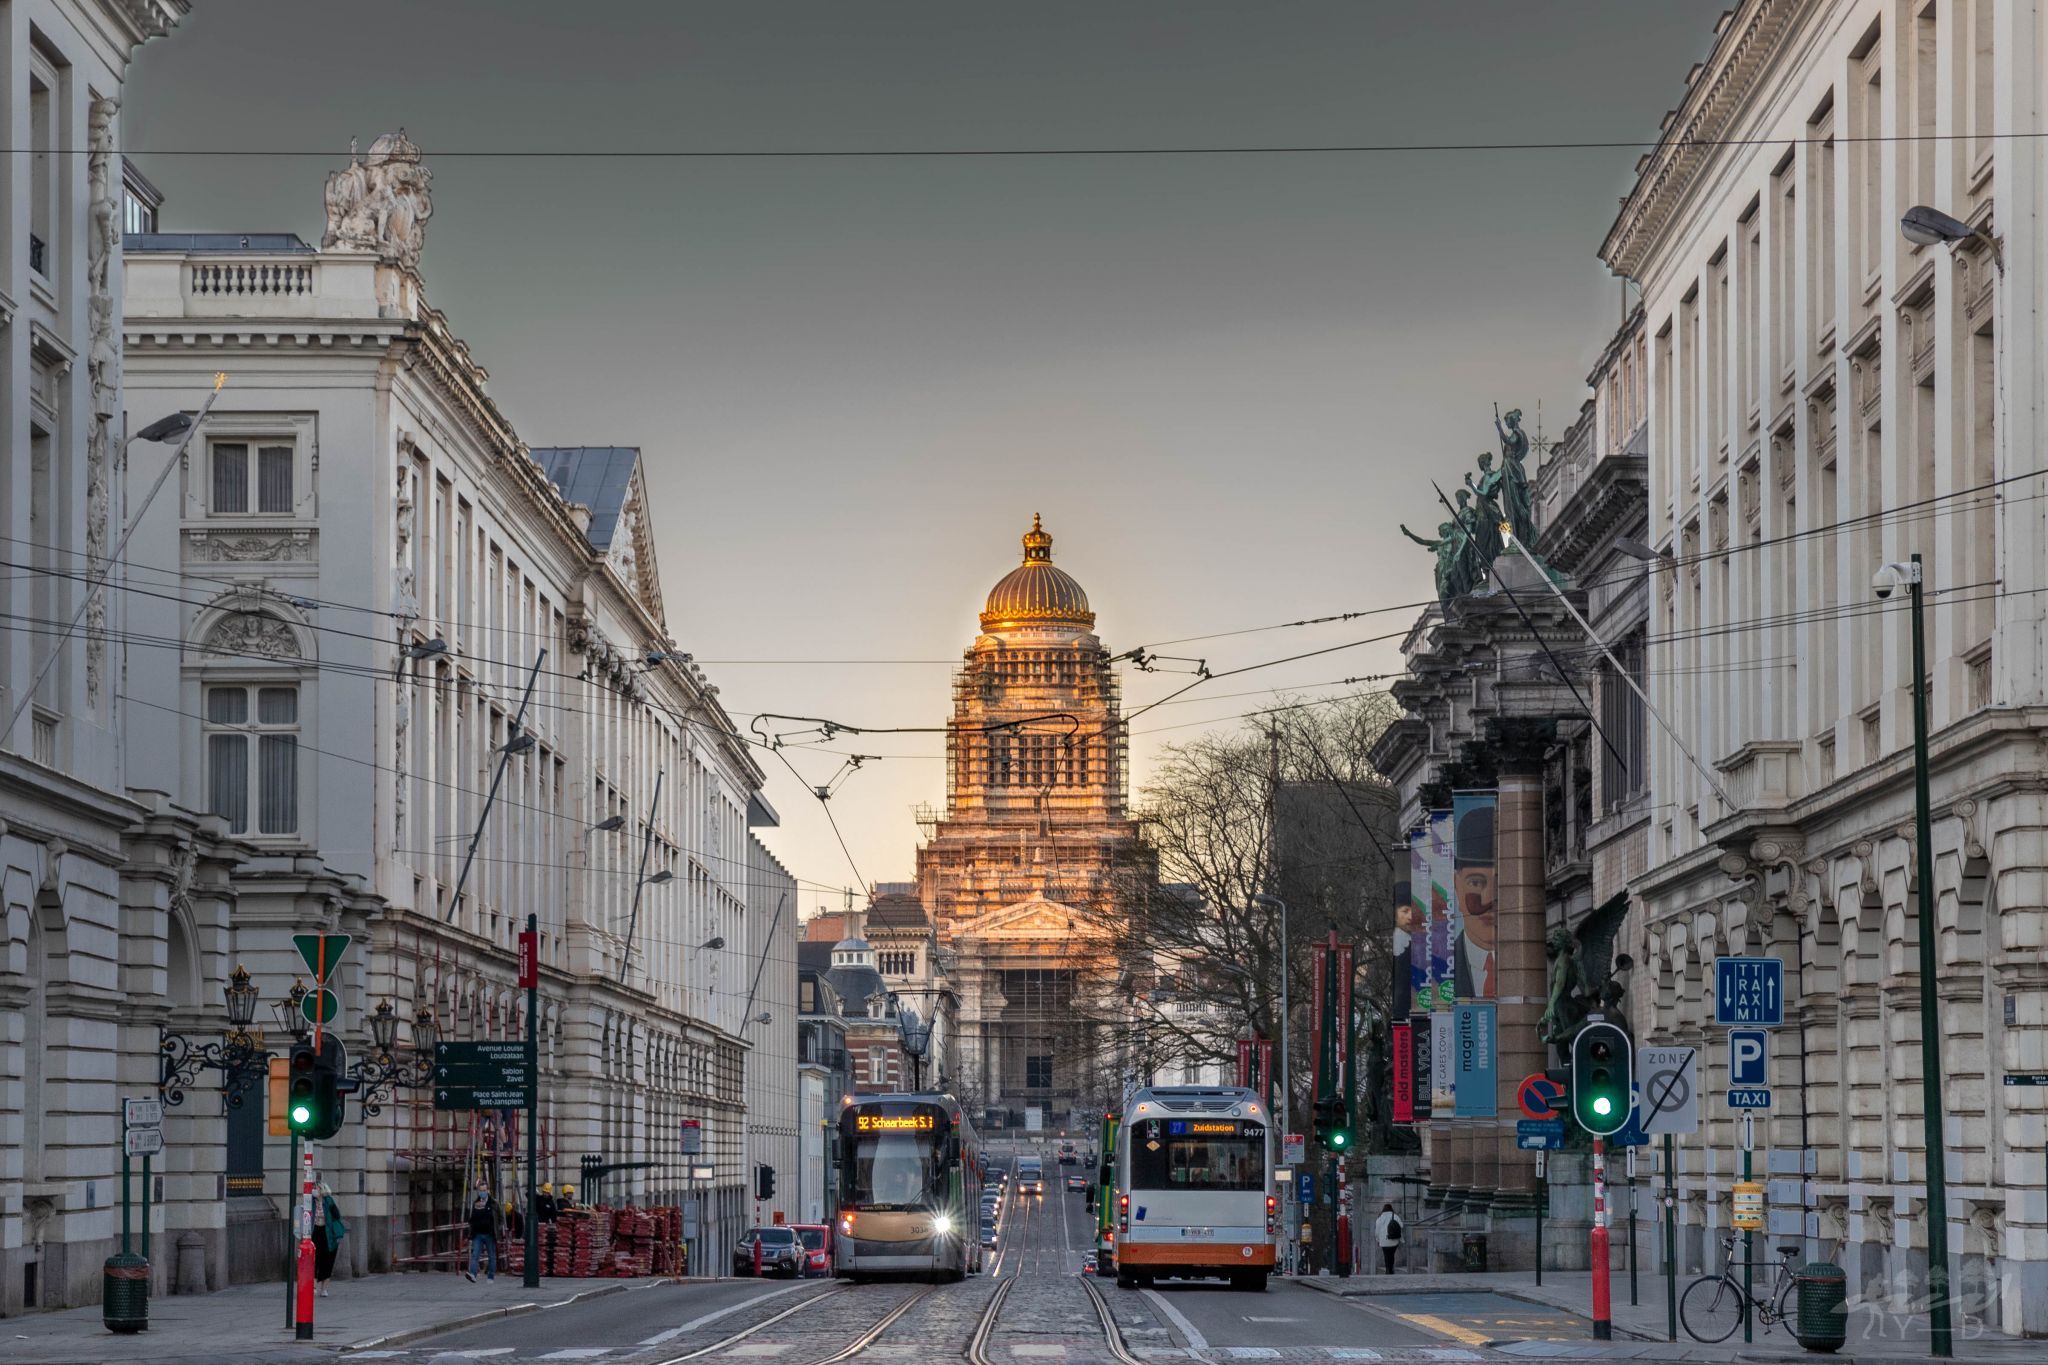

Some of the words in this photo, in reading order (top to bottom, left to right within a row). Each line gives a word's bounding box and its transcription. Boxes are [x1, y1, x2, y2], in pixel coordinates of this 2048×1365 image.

[1737, 964, 1749, 1021] TRAM
[1751, 964, 1761, 1021] TAXI
[1417, 1030, 1430, 1072] VIOLA
[1459, 1011, 1474, 1072] magritte
[1478, 1011, 1488, 1069] museum
[1400, 1031, 1409, 1080] masters
[1648, 1053, 1686, 1064] ZONE
[1733, 1039, 1762, 1078] P
[1399, 1082, 1409, 1102] old
[1418, 1074, 1430, 1101] BILL
[1733, 1092, 1766, 1105] TAXI
[858, 1116, 869, 1130] 92
[872, 1116, 918, 1129] Schaarbeek
[919, 1116, 927, 1128] S.
[1193, 1124, 1235, 1133] Zuidstation
[1243, 1128, 1265, 1137] 9477
[1302, 1175, 1311, 1188] P
